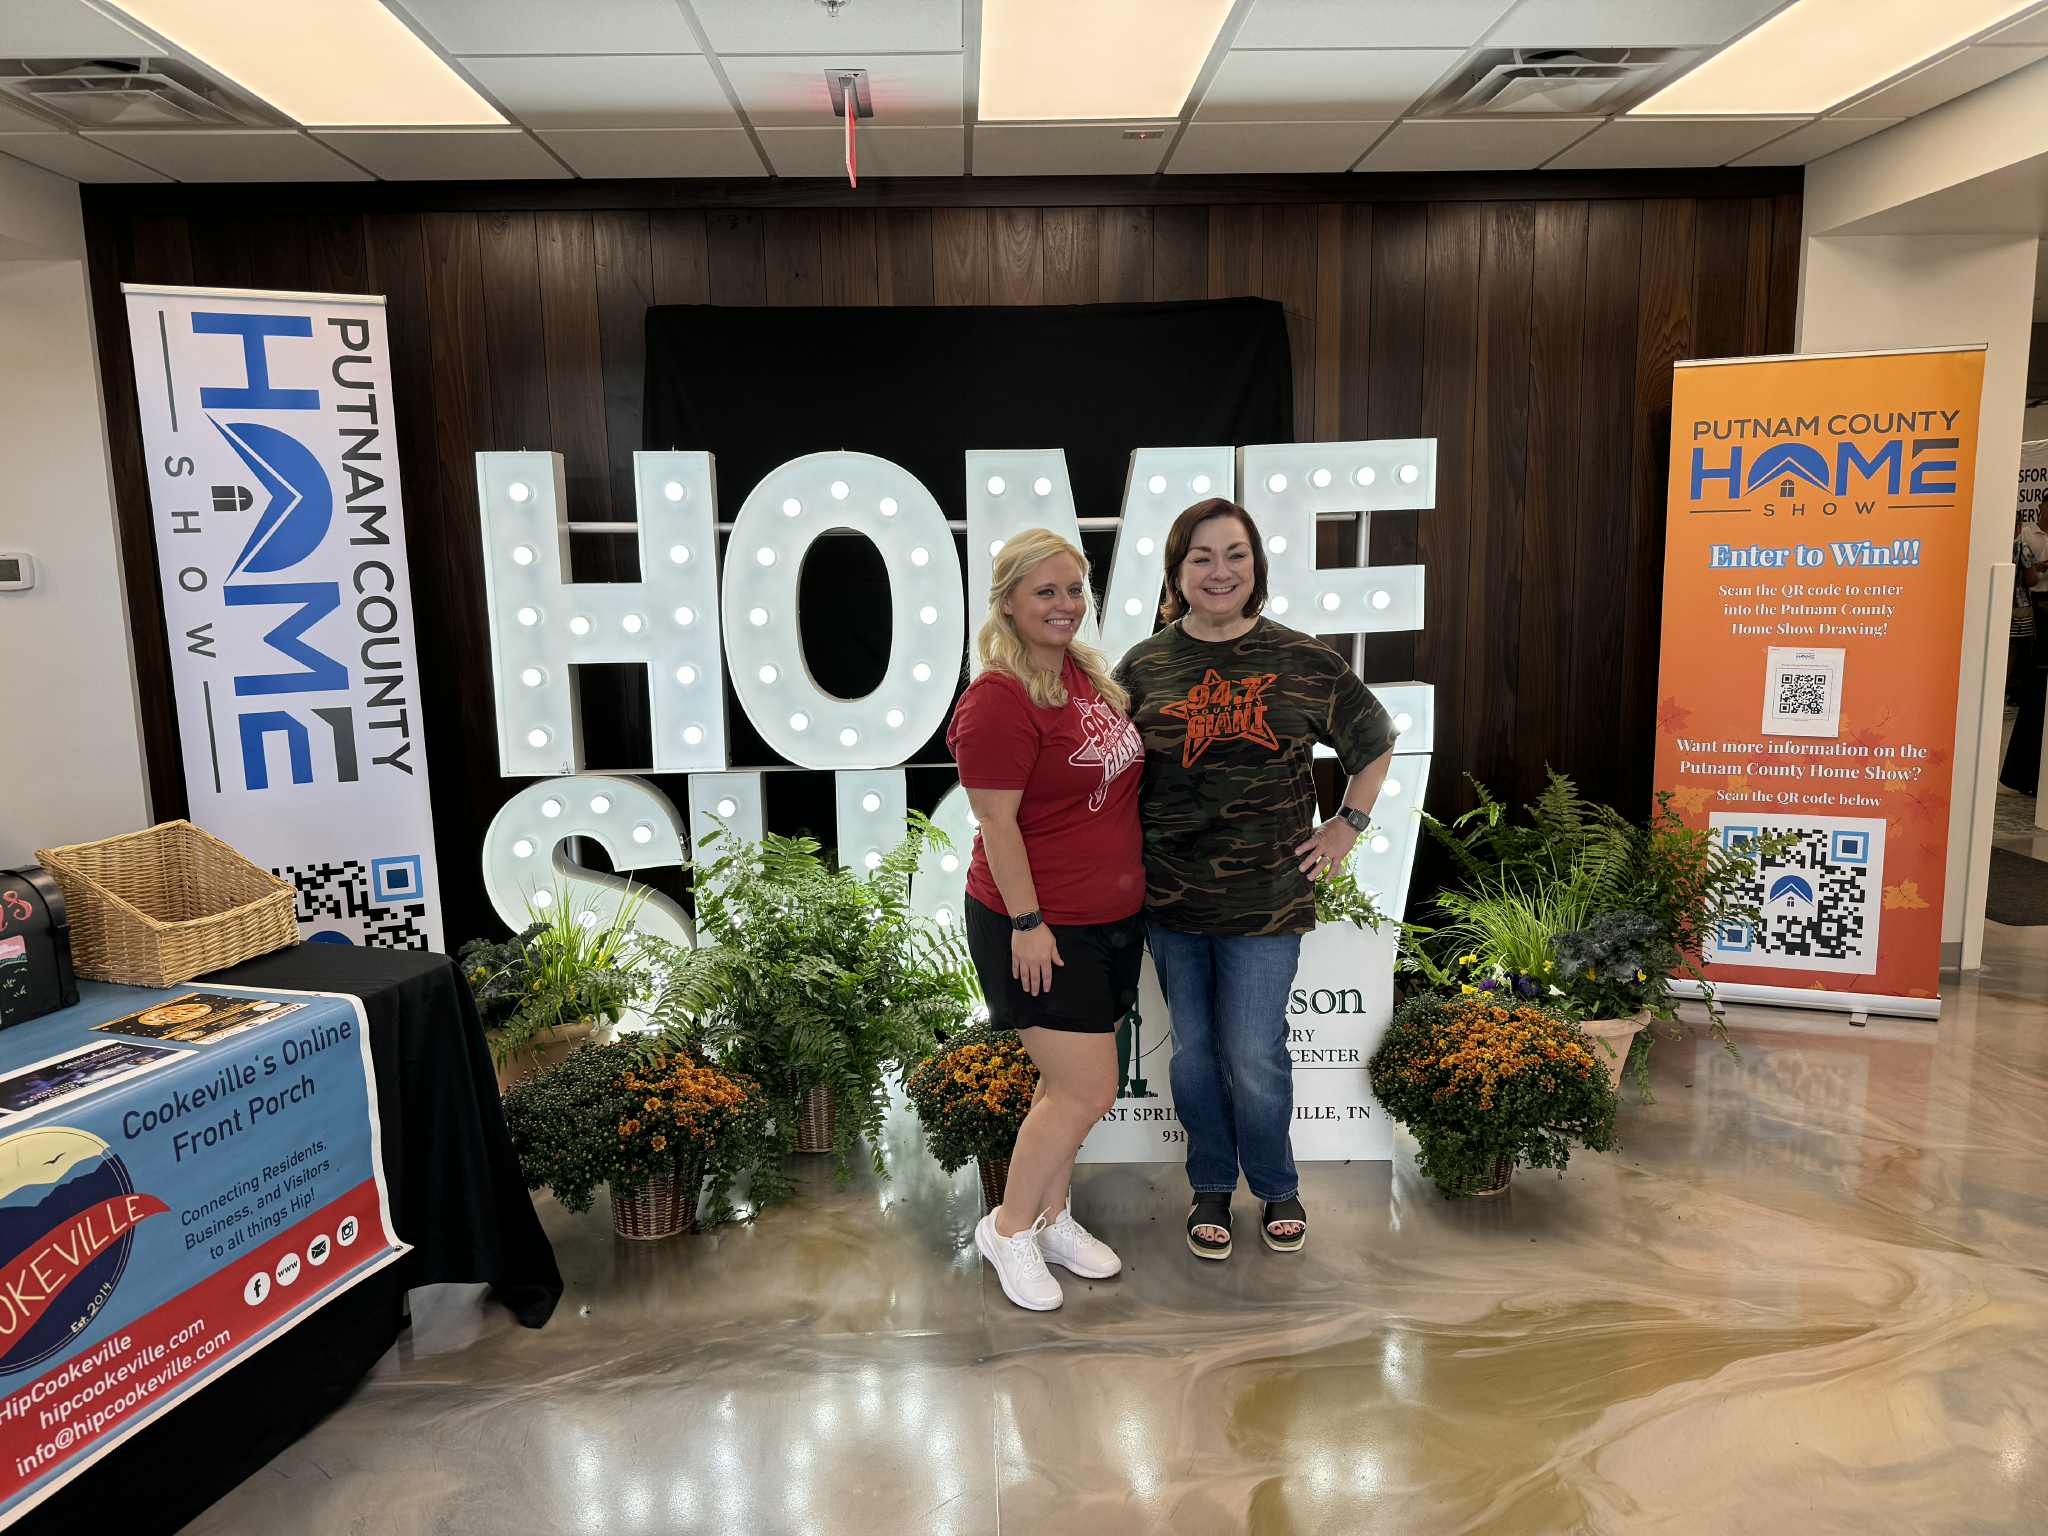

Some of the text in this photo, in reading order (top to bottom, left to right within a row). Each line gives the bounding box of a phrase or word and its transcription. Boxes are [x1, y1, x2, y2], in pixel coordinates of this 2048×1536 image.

[1693, 410, 1960, 441] PUTNAM COUNTY
[1690, 437, 1960, 500] HOME
[1763, 501, 1876, 517] SHOW
[164, 455, 217, 660] SHOW
[190, 311, 360, 791] HOME
[327, 316, 414, 776] PUTNAM COUNTY
[1709, 540, 1920, 568] Enter to Win!!!
[1719, 583, 1904, 597] Scan the QR code to enter
[1724, 603, 1896, 617] into the Putnam County
[1731, 622, 1888, 637] Home Show Drawing!
[1188, 677, 1263, 709] 94.7
[1187, 705, 1268, 738] GIANT
[1677, 739, 1927, 758] Want more information on the
[1680, 761, 1922, 781] Putnam County Home Show?
[1717, 790, 1882, 807] Scan the QR code below
[1286, 989, 1367, 1014] son
[1290, 1049, 1360, 1062] CENTER
[122, 1053, 277, 1141] Cookeville's
[281, 1020, 352, 1066] Online
[173, 1074, 315, 1163] Front Porch
[1346, 1106, 1370, 1119] TN
[1162, 1130, 1185, 1143] 931
[257, 1184, 281, 1209] and
[283, 1158, 330, 1193] Visitors
[181, 1177, 260, 1226] Connecting
[209, 1187, 316, 1260] to all things Hip!
[277, 1260, 298, 1279] www
[70, 1282, 113, 1333] Est. 2014
[0, 1335, 132, 1427] HipCookeville
[39, 1317, 205, 1430] hipcookeville.com
[15, 1329, 231, 1478] info@hipcookeville.com
